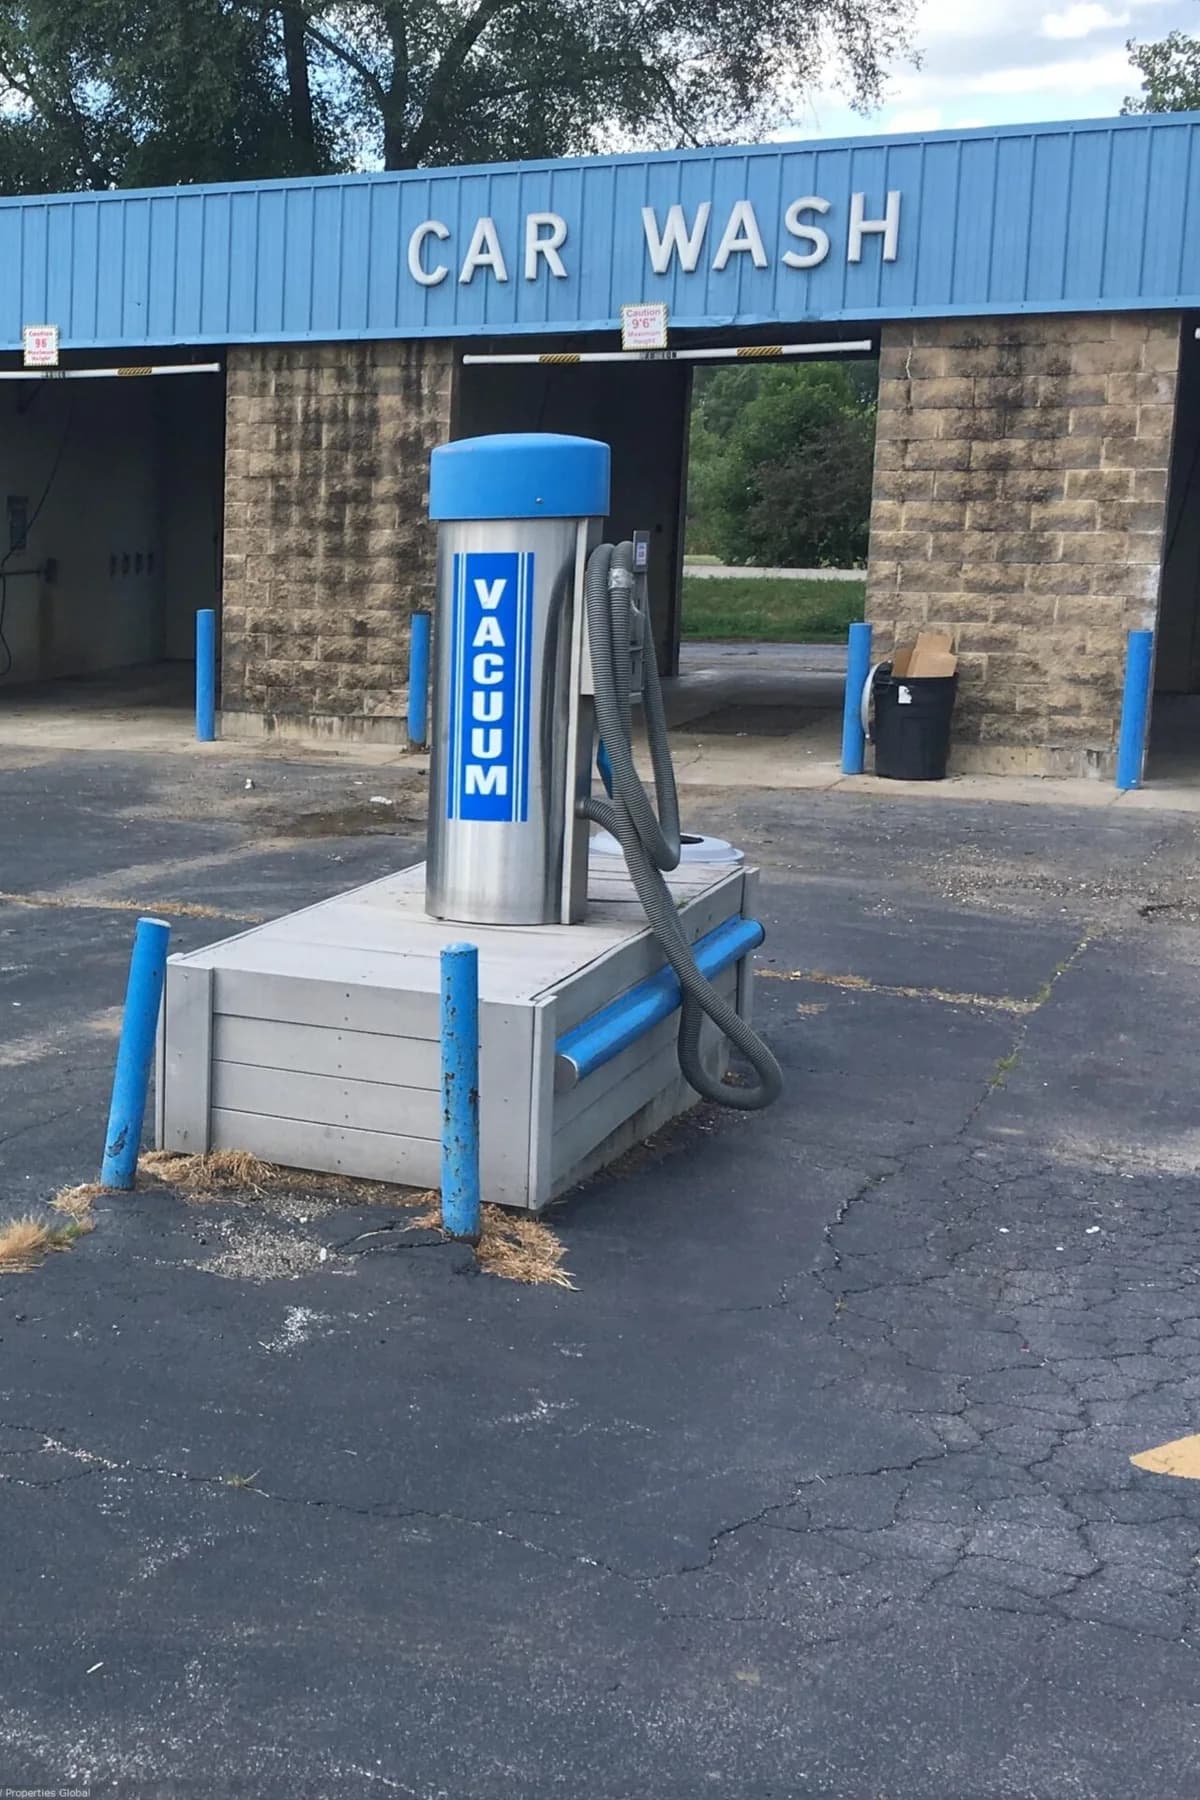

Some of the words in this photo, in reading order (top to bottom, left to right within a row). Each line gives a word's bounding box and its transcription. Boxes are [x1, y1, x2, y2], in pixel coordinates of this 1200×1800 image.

[407, 212, 568, 287] CAR
[640, 190, 901, 274] WASH
[626, 308, 661, 317] Caution
[464, 578, 508, 796] VACUUM
